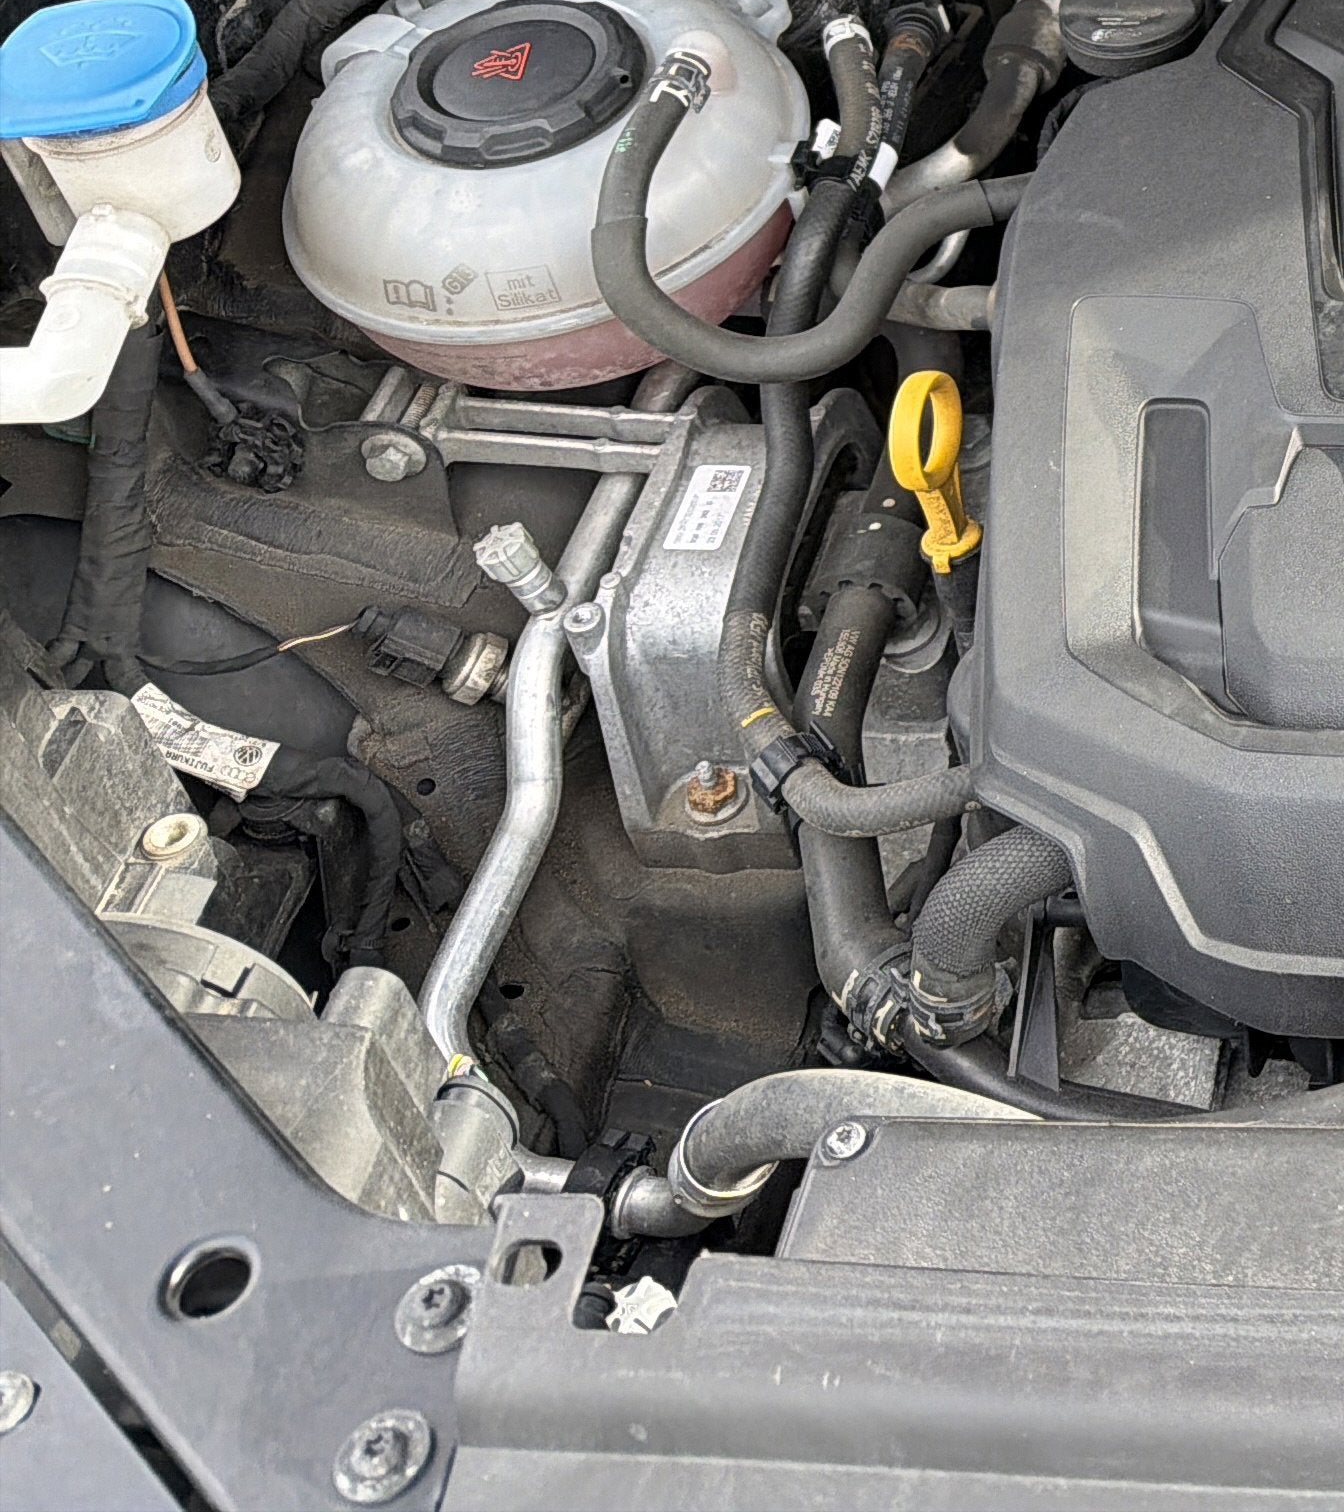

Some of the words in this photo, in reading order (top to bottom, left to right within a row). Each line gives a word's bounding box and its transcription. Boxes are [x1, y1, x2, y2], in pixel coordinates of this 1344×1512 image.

[507, 274, 536, 291] mit
[498, 289, 556, 308] Silikat
[165, 750, 215, 773] FUJIKURA
